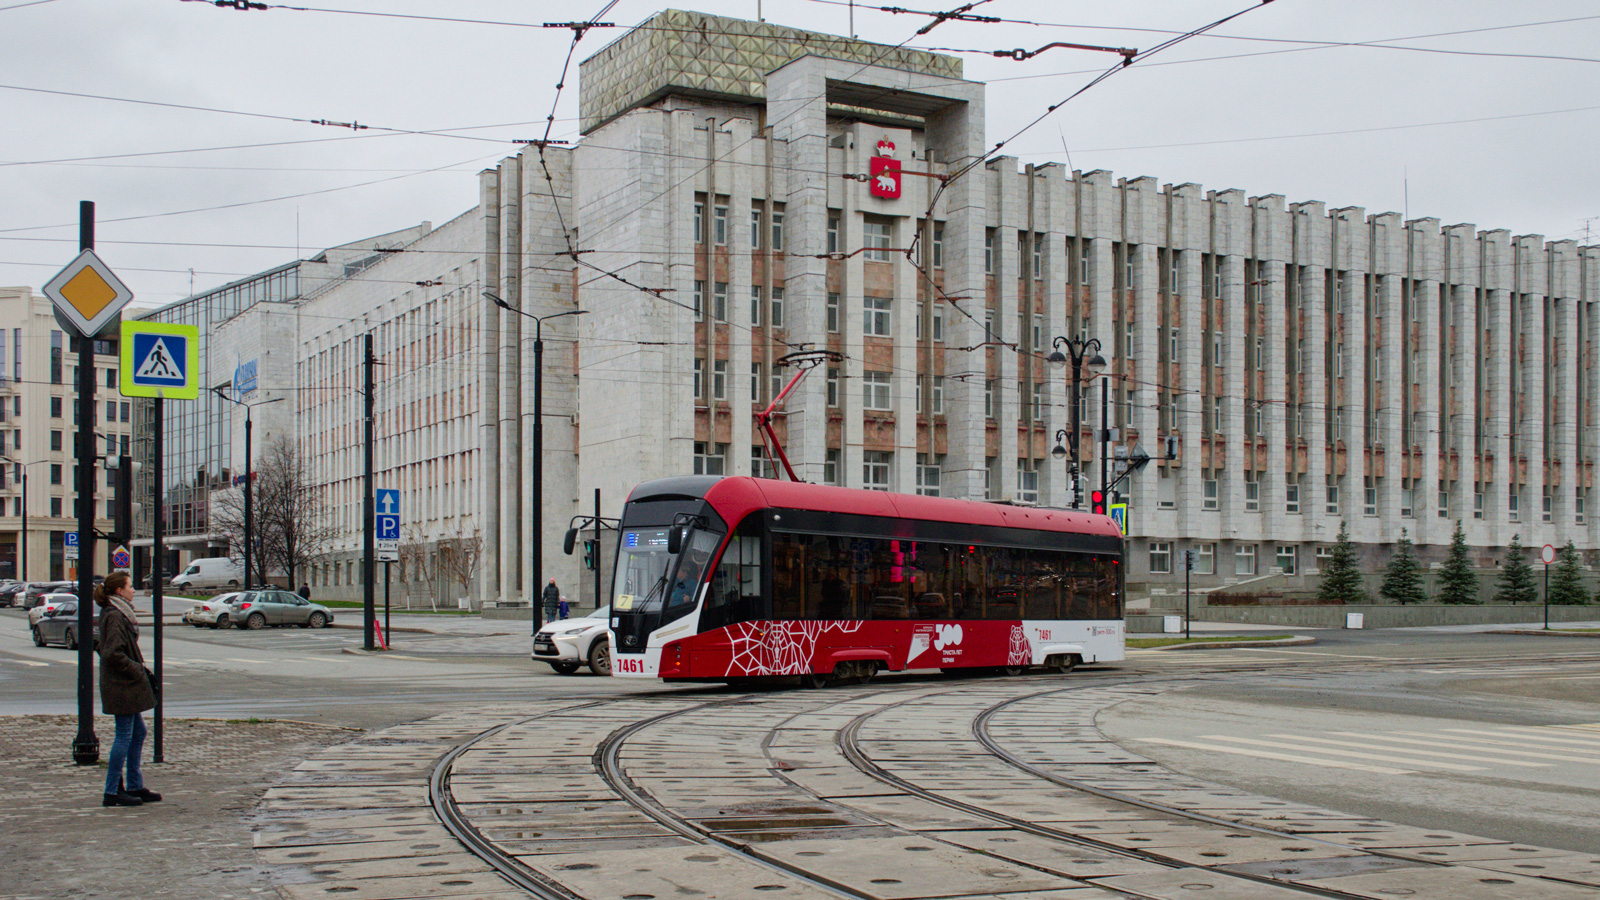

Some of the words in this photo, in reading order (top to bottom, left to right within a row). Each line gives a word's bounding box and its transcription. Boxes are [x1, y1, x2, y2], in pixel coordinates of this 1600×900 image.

[383, 517, 396, 537] P
[69, 534, 77, 545] P
[621, 595, 629, 607] 7
[934, 624, 963, 651] 300
[1039, 629, 1052, 641] 7461
[617, 659, 644, 673] 7461
